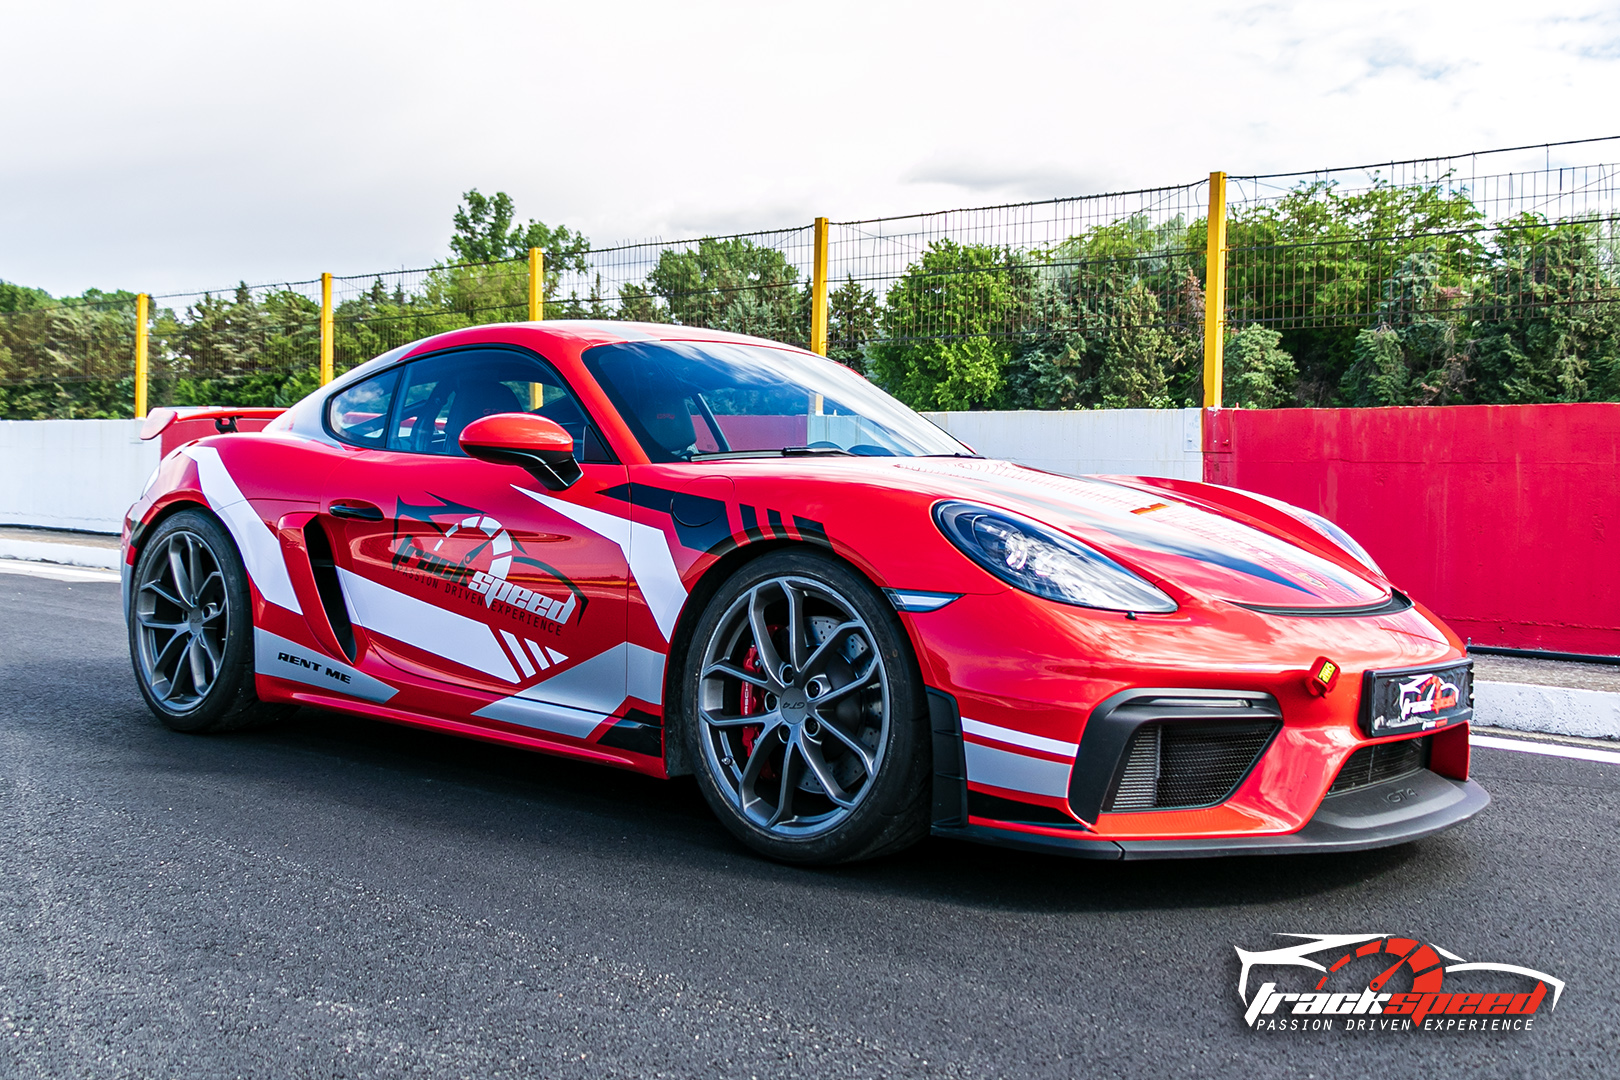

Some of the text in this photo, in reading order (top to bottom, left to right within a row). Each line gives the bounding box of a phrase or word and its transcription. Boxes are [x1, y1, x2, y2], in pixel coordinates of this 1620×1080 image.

[397, 564, 563, 637] PASSION DRIVEN EXPERIENCE
[277, 651, 352, 685] RENT ME
[1386, 787, 1419, 803] GT4
